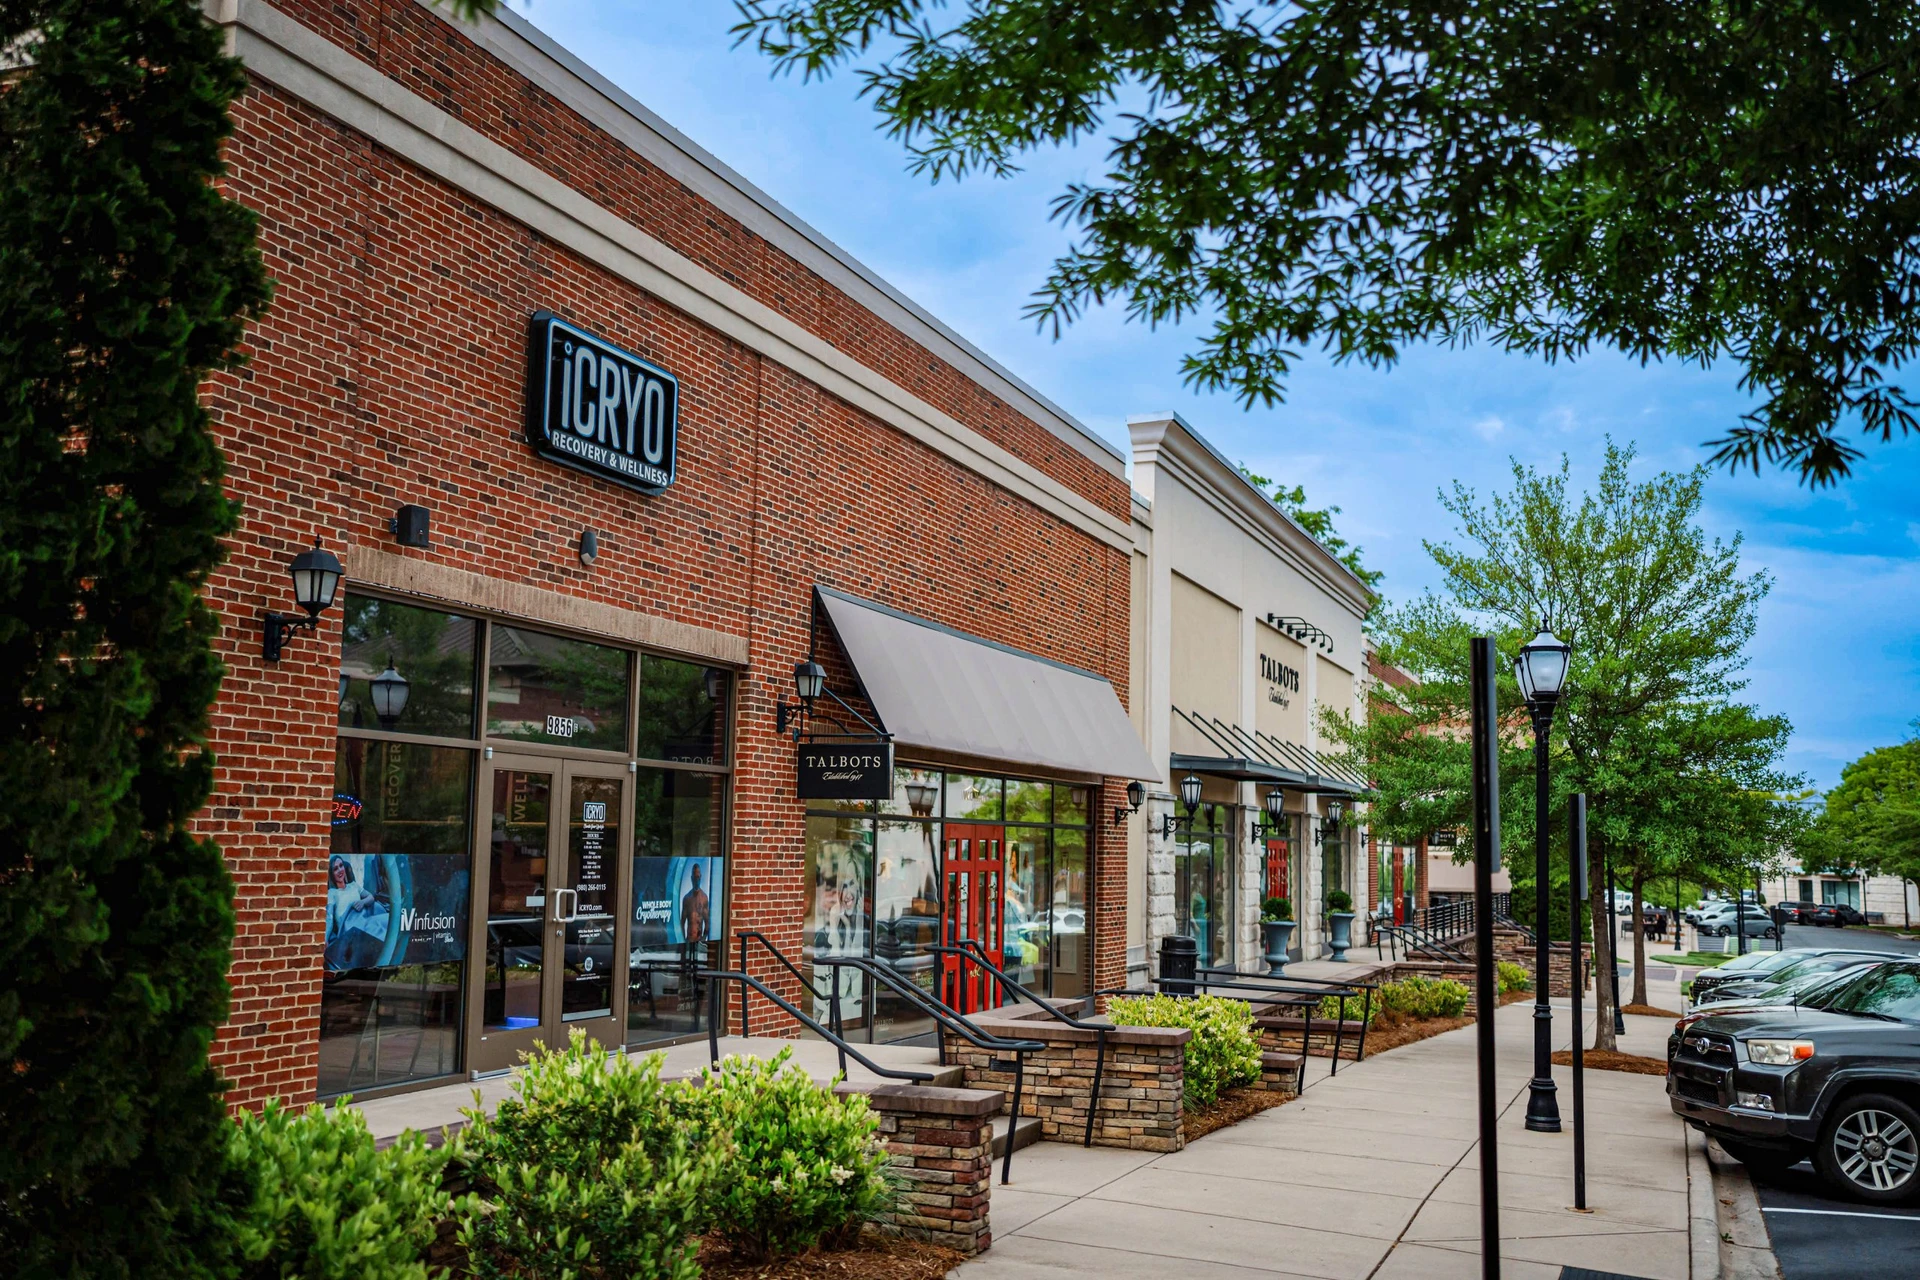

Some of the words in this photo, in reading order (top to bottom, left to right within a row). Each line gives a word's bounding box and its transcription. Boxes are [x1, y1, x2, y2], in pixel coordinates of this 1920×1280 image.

[561, 340, 665, 465] iCRYO
[552, 430, 608, 464] RECOVERY
[609, 452, 617, 468] &
[618, 455, 668, 486] WELLNESS
[1260, 653, 1299, 693] TALBOTS
[548, 716, 572, 736] 9856
[806, 755, 881, 768] TALBOTS
[332, 802, 363, 819] PEN
[586, 804, 604, 820] iCRYO
[642, 900, 659, 909] WHOLE
[660, 900, 672, 908] BODY
[414, 911, 456, 930] infusion
[636, 906, 672, 924] Cryotherapy
